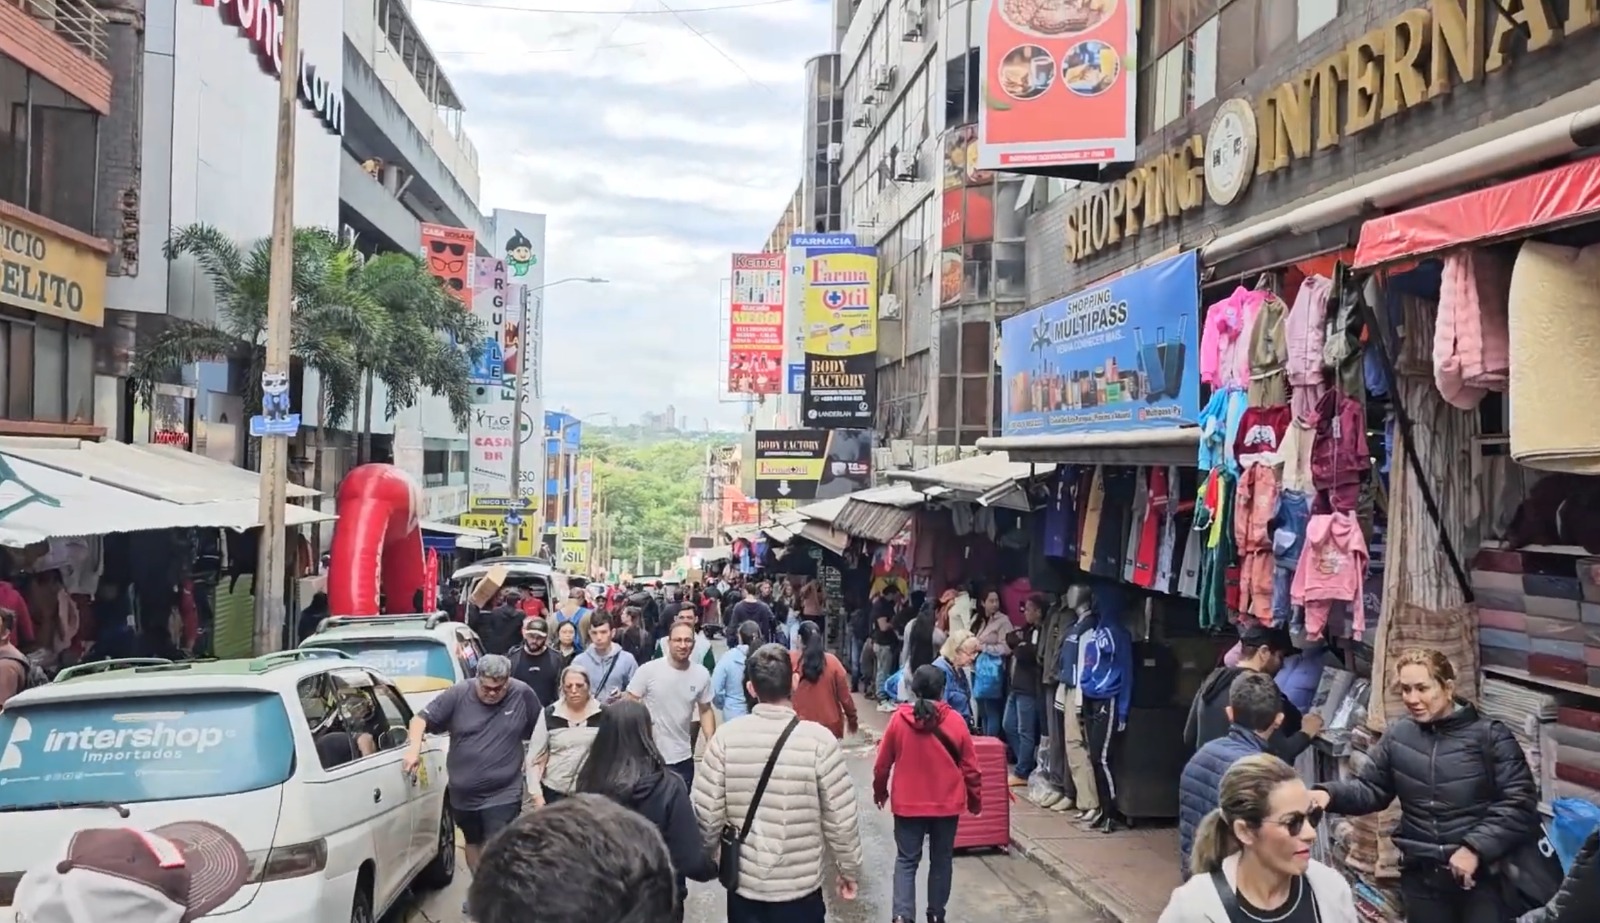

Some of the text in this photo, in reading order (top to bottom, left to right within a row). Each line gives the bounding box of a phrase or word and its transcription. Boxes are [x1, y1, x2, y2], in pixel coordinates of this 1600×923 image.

[1064, 0, 1600, 263] SHOPPING INTERNA
[0, 223, 46, 261] ICIO
[795, 237, 852, 245] FARMACIA
[811, 260, 868, 282] Farma
[1068, 288, 1111, 316] SHOPPING
[1054, 301, 1128, 341] MULTIPASS
[811, 360, 847, 374] BODY
[811, 374, 867, 388] FACTORY
[474, 437, 512, 447] CASA
[757, 440, 820, 450] BODY FACTORY
[484, 452, 503, 461] BR
[43, 721, 223, 753] intershop
[82, 749, 183, 763] Importados
